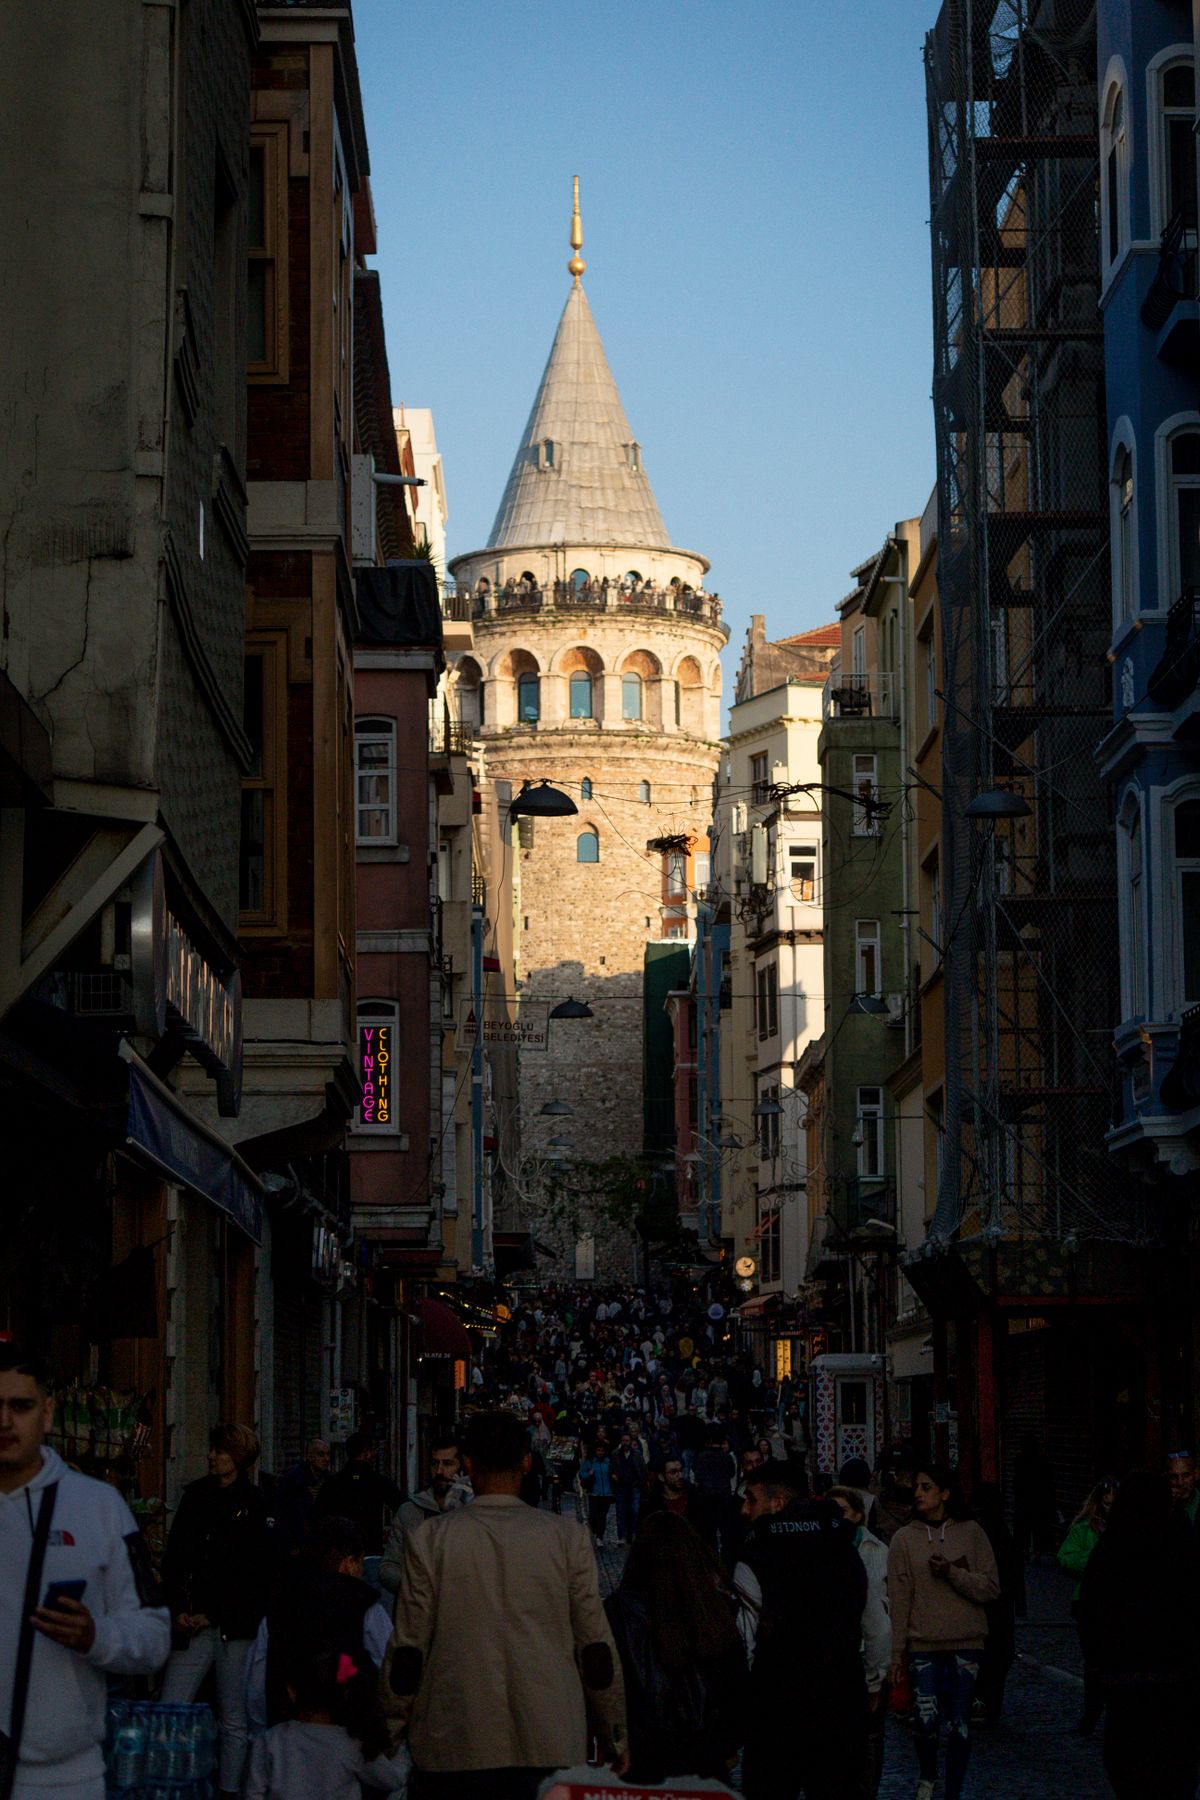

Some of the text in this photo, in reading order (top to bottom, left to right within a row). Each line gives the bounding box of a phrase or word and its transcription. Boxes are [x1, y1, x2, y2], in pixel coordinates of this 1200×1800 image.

[483, 1033, 544, 1043] BELEDİYESİ
[363, 1029, 375, 1122] VINTAGE
[377, 1028, 389, 1122] CLOTHING
[769, 1520, 821, 1534] MONCLER
